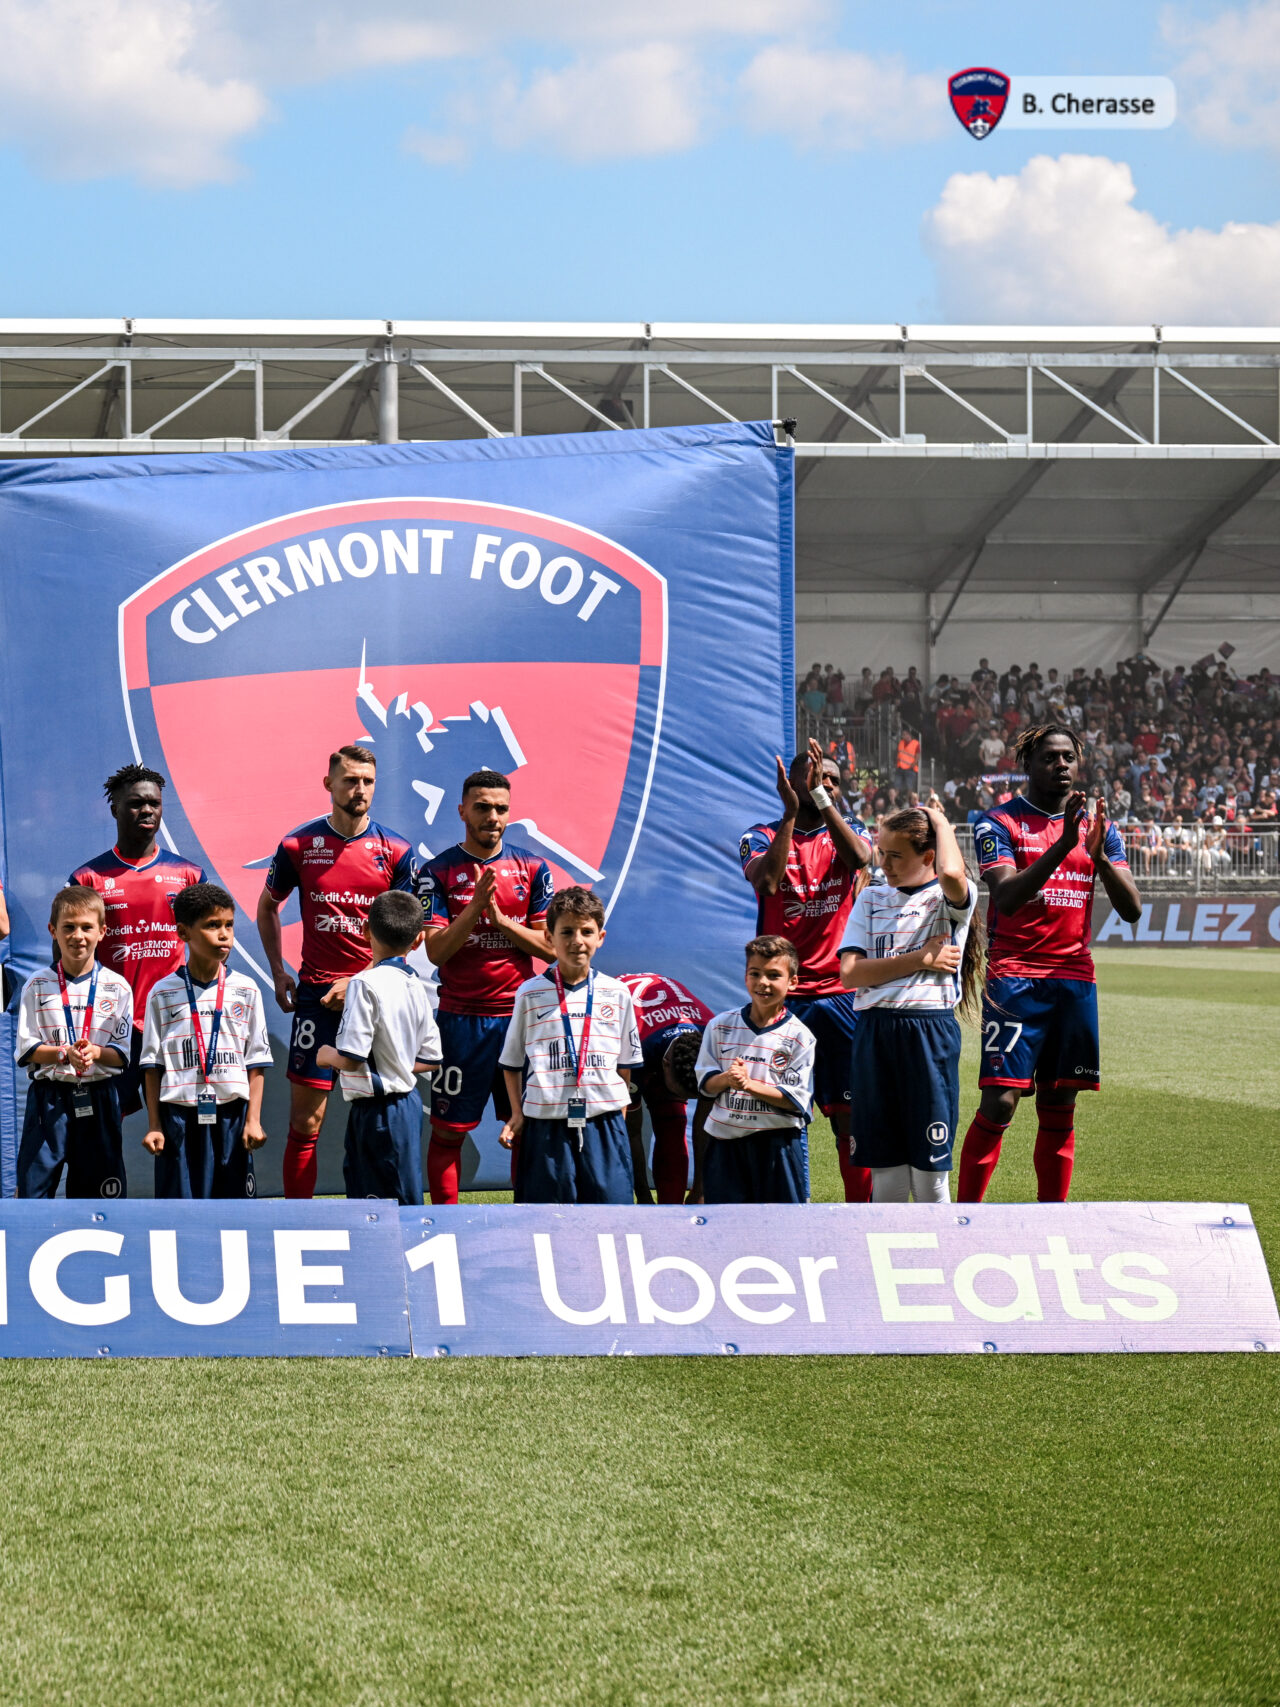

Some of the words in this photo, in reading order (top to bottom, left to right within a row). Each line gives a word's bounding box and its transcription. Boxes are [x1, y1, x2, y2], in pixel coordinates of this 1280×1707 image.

[170, 528, 453, 644] CLERMONT
[470, 533, 621, 622] FOOT
[310, 892, 340, 902] Crédit
[354, 893, 374, 905] Mut
[1044, 888, 1092, 900] CLERMONT
[1044, 897, 1083, 908] FERRAND
[106, 925, 133, 936] Crédit
[151, 922, 177, 932] Mutue
[1095, 904, 1257, 941] ALLEZ
[130, 940, 177, 951] CLERMONT
[131, 949, 171, 960] FERRAND
[293, 1017, 316, 1050] 18
[984, 1021, 1022, 1052] 27
[432, 1065, 463, 1096] 20
[406, 1233, 468, 1326] 1
[532, 1233, 837, 1326] Uber
[866, 1230, 1180, 1322] Eats
